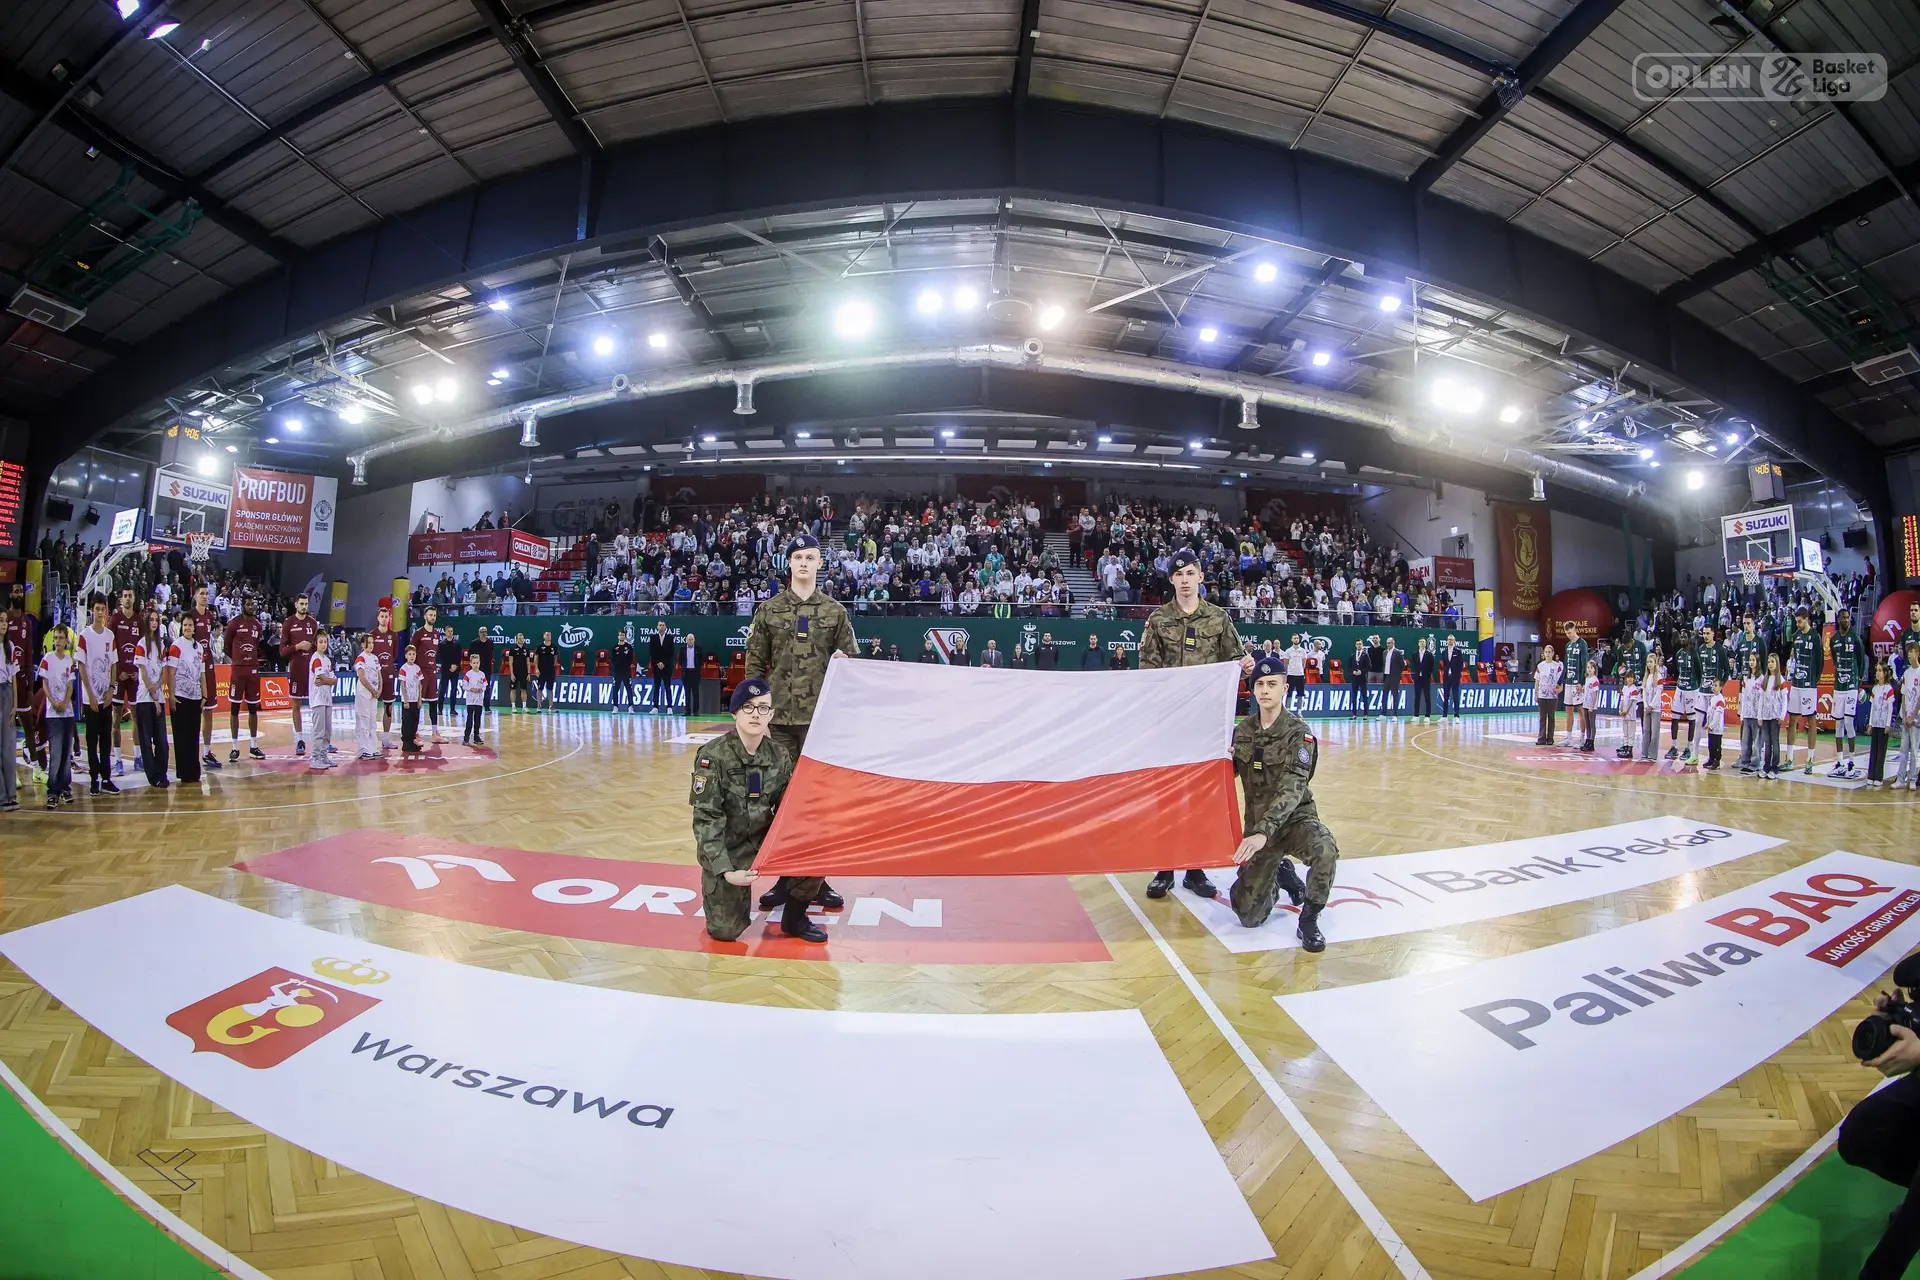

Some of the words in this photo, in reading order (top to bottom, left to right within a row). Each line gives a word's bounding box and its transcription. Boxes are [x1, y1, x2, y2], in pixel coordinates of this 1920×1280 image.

[184, 426, 200, 440] 4:06
[1755, 463, 1769, 475] 4:06
[182, 485, 228, 505] SUZUKI
[238, 477, 307, 505] PROFBUD
[235, 509, 271, 521] SPONSOR
[272, 511, 304, 523] GŁÓWNY
[1745, 514, 1788, 532] SUZUKI
[234, 521, 264, 531] AKADEMII
[265, 523, 303, 534] KOSZYKÓWKI
[233, 532, 254, 542] LEGII
[255, 533, 301, 545] WARSZAWA
[514, 540, 531, 554] ORLEN
[564, 630, 587, 644] LOTTO
[727, 638, 746, 646] ORLE
[1845, 644, 1854, 652] 12
[552, 681, 592, 704] LEGIA
[1459, 688, 1485, 708] EGIA
[1412, 855, 1604, 894] Bank
[1580, 828, 1734, 864] Pekao
[1825, 929, 1872, 961] JAKOŚĆ
[1865, 909, 1900, 933] GRUPY
[1460, 941, 1764, 1051] Paliwa
[1706, 873, 1896, 947] BAQ
[350, 1031, 676, 1131] Warszawa
